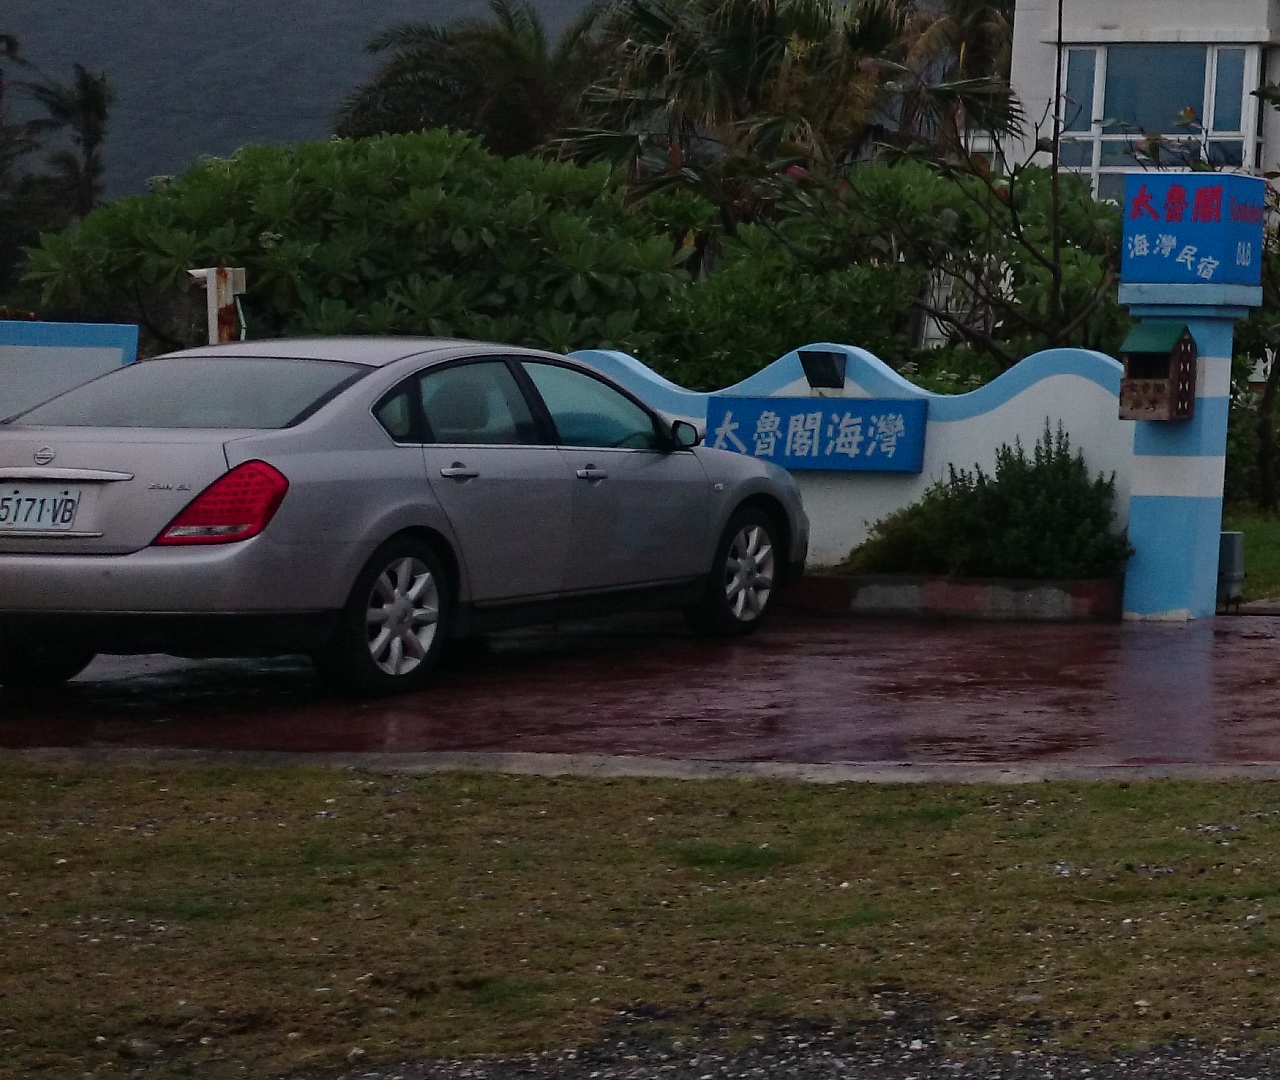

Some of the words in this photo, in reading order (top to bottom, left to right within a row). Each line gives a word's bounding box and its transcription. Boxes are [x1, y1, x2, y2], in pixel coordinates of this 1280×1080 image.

[1130, 184, 1223, 223] 太魯閣
[1127, 233, 1220, 280] 海灣民宿
[713, 410, 905, 459] 太魯閣海灣
